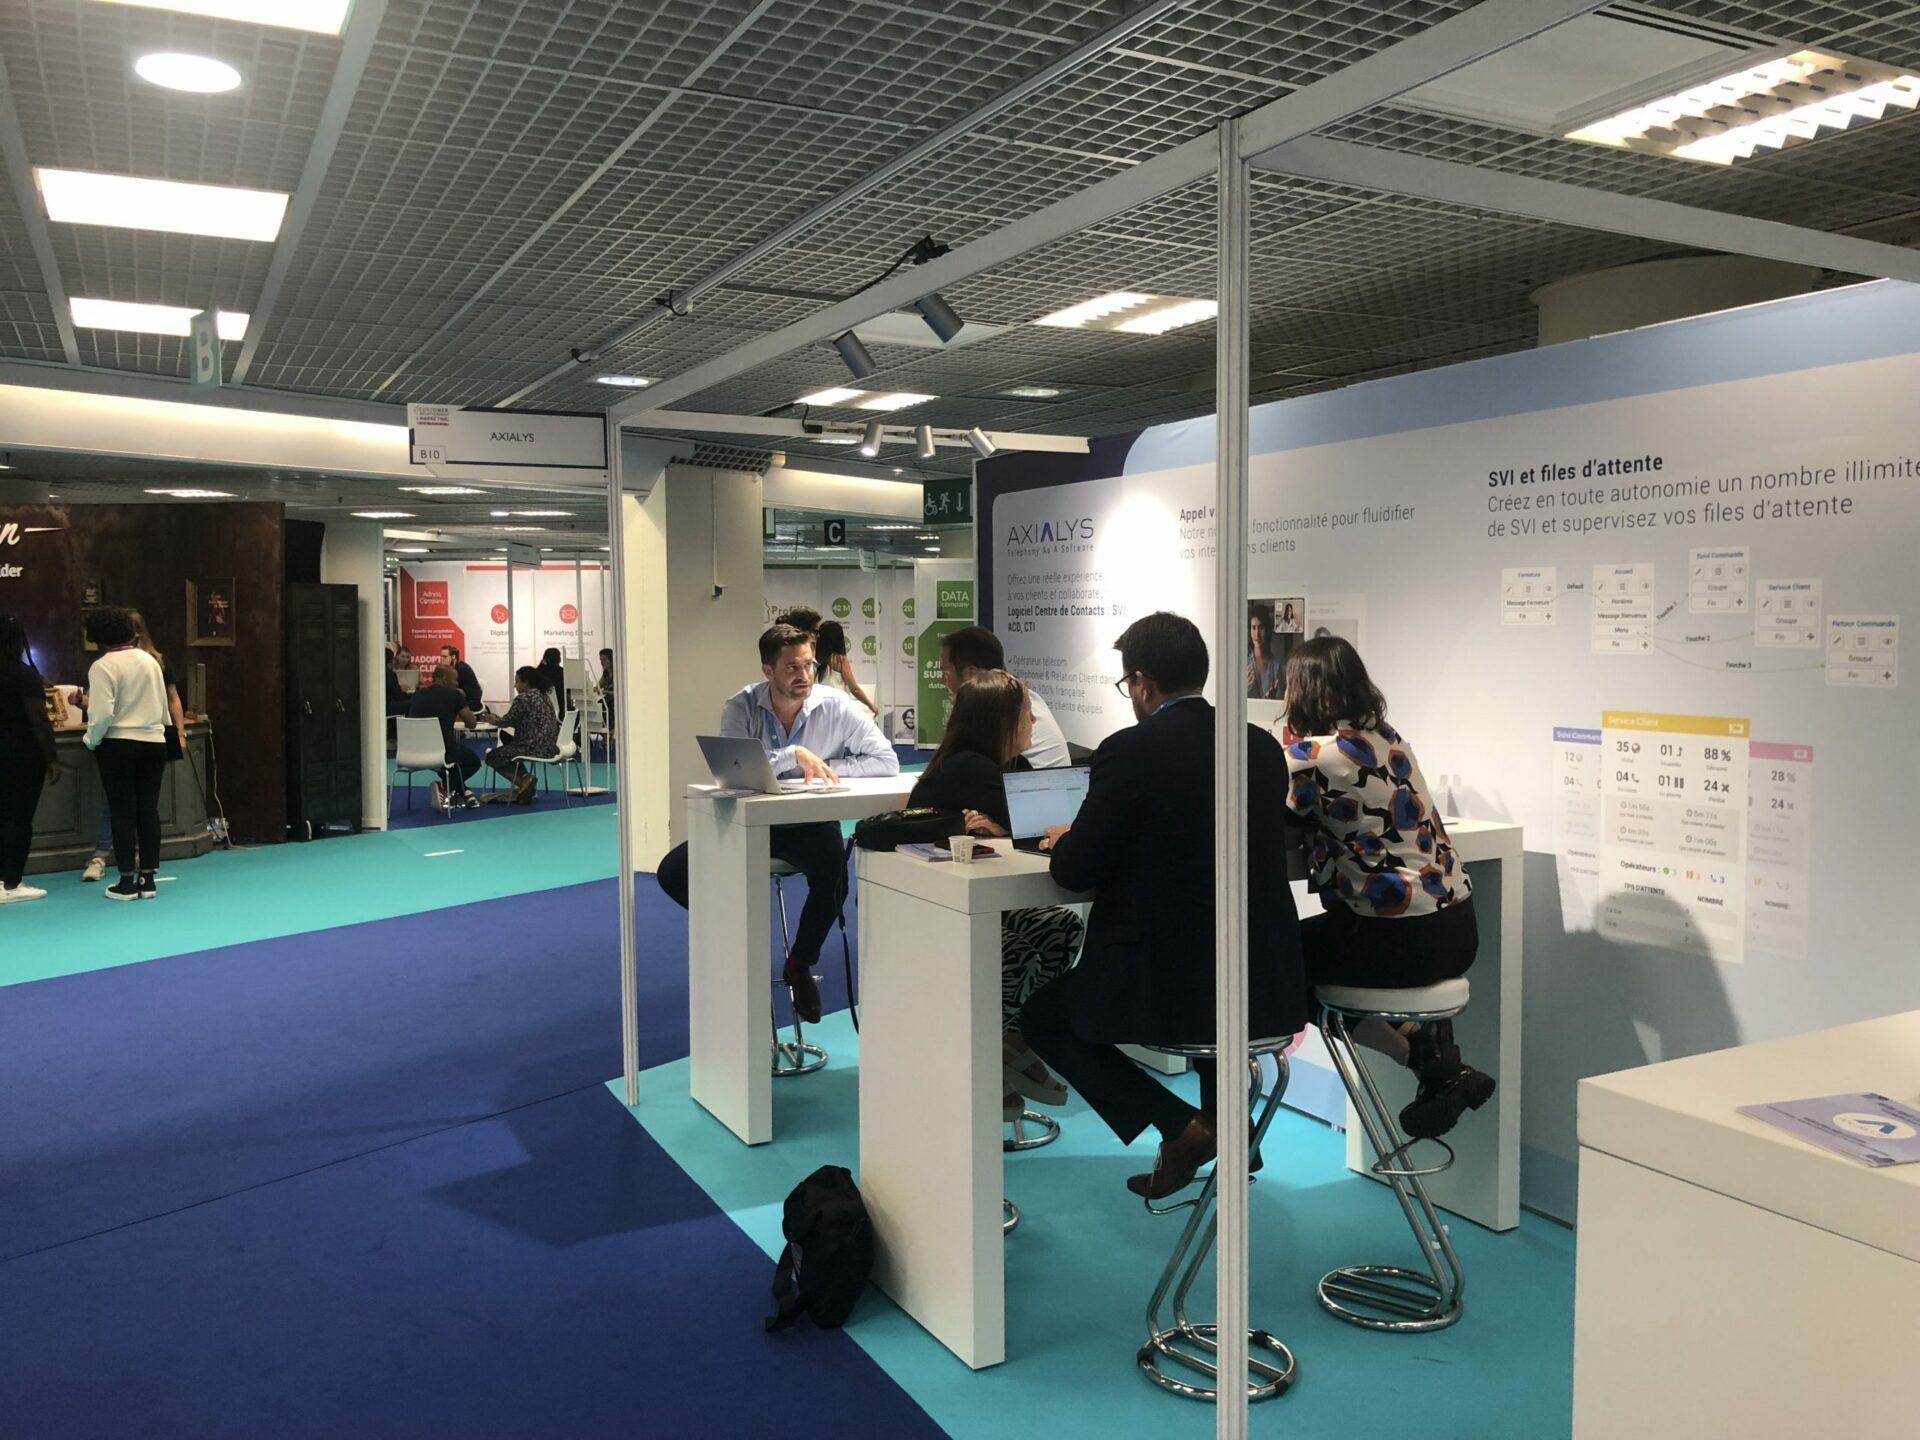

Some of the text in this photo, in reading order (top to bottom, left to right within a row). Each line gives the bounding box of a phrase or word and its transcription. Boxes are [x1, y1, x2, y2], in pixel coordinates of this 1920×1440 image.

[196, 320, 214, 384] B
[490, 432, 535, 442] AXIALYS
[1488, 454, 1664, 488] SVI et files d'attente
[1488, 492, 1531, 513] Créez
[1536, 493, 1556, 510] en
[1561, 488, 1604, 508] toute
[1610, 476, 1711, 504] autonomie
[1718, 477, 1743, 494] un
[1750, 465, 1837, 494] nombre
[1180, 506, 1206, 524] Appel
[1488, 494, 1854, 539] de SVI et supervisez vos files d'attente
[1180, 528, 1206, 541] Notre
[1252, 512, 1328, 536] fonctionnalité
[1332, 513, 1359, 530] pour
[1363, 504, 1416, 526] fluidifier
[828, 522, 842, 543] C
[1007, 518, 1094, 546] AXIALYS
[1008, 548, 1040, 558] Telephony
[1062, 544, 1094, 554] Software
[1198, 546, 1217, 558] inte
[1260, 538, 1296, 555] clients
[0, 563, 24, 578] der
[1008, 574, 1026, 586] Offrez
[1028, 575, 1041, 584] une
[941, 591, 969, 602] DATA
[1013, 593, 1024, 601] vos
[1026, 589, 1048, 600] clients
[1050, 588, 1058, 600] et
[1008, 606, 1034, 618] Logiciel
[1034, 605, 1058, 616] Centre
[1060, 604, 1069, 616] de
[1070, 604, 1105, 616] Contacts
[544, 630, 574, 638] Marketing
[1024, 622, 1036, 632] CTI
[1046, 671, 1050, 680] &
[1564, 751, 1575, 762] 12
[1616, 741, 1629, 752] 35
[1660, 744, 1673, 756] 01
[1704, 748, 1718, 760] 88
[1564, 776, 1575, 786] 04
[1616, 771, 1718, 792] 04 01 24
[1771, 770, 1785, 782] 28
[1770, 798, 1784, 810] 24
[1620, 860, 1656, 874] Opérateurs
[1697, 895, 1724, 908] NOMBRE
